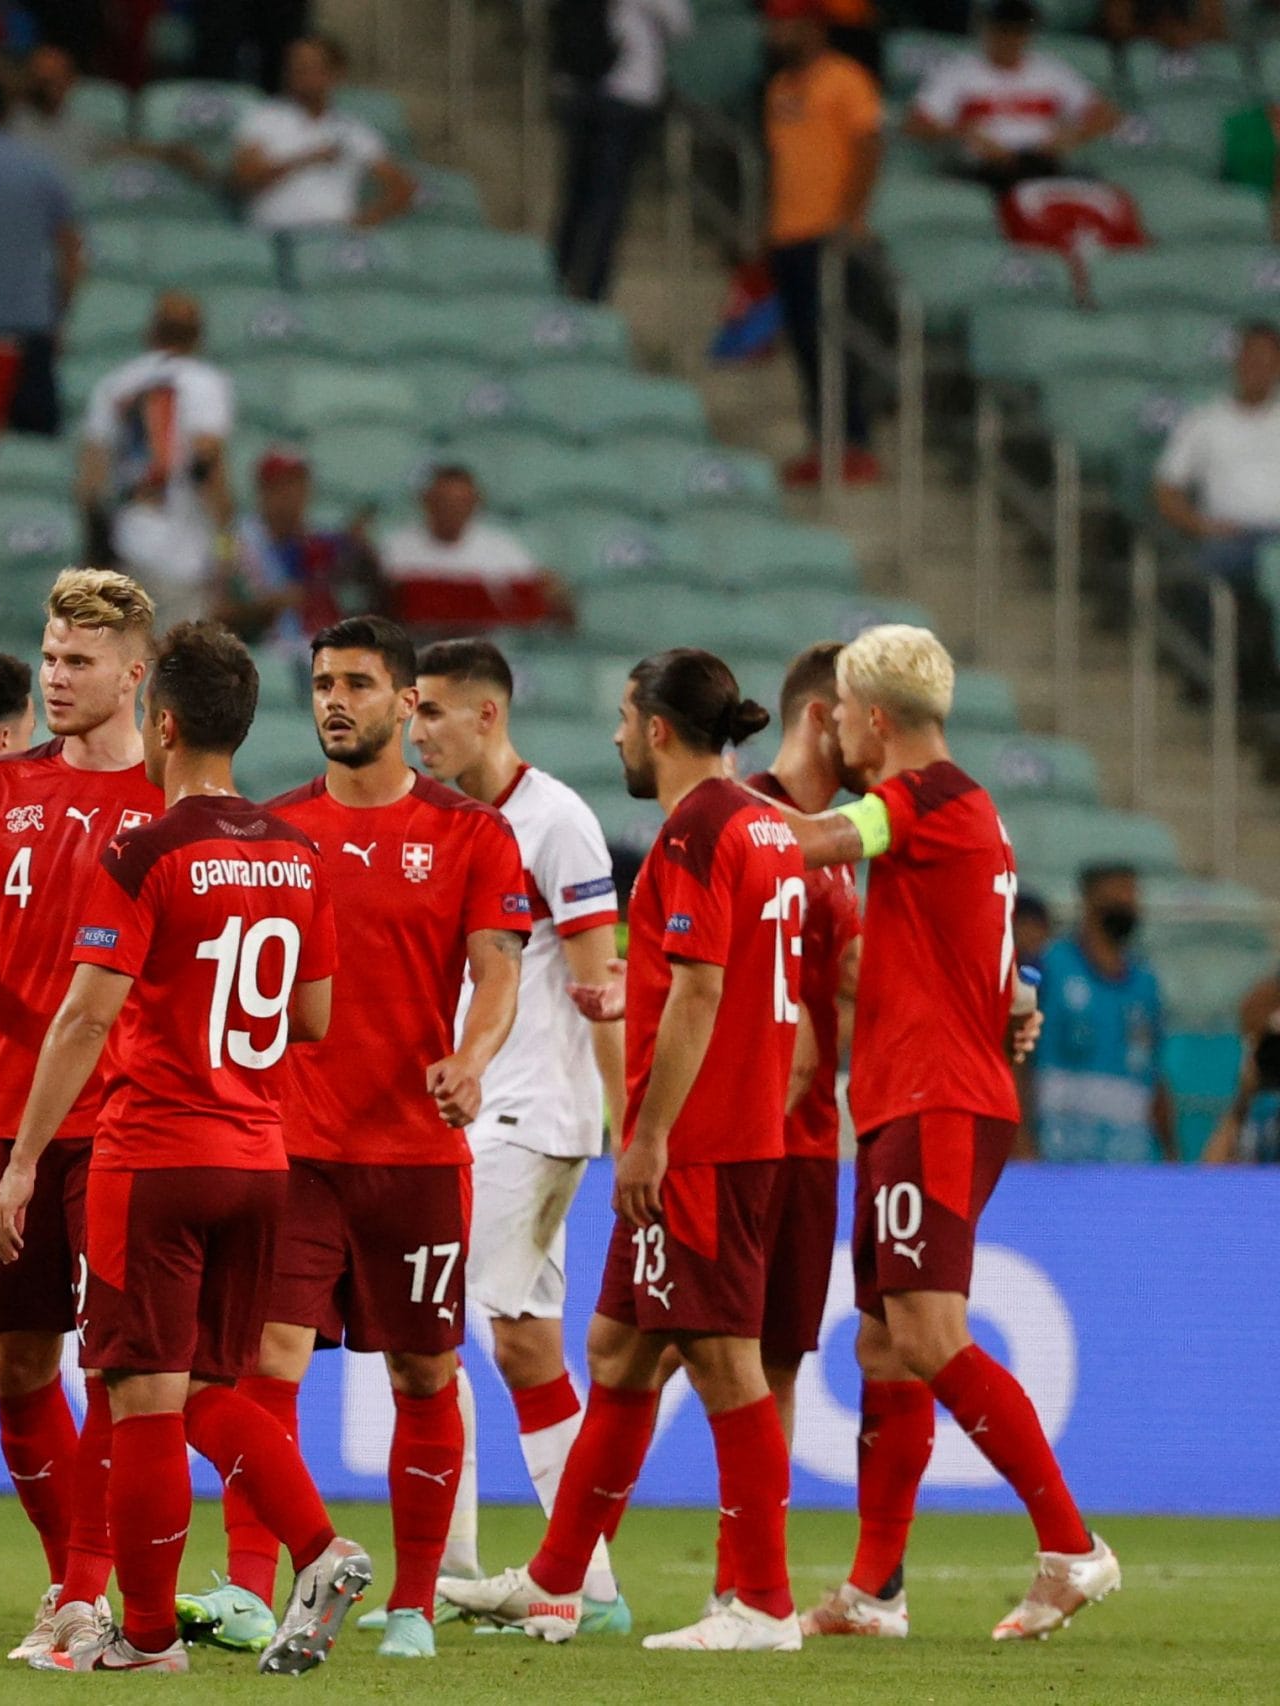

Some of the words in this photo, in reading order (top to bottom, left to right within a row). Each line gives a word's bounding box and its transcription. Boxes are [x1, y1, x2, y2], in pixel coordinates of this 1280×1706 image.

[4, 846, 33, 909] 4
[191, 855, 312, 895] gavranovic
[195, 916, 300, 1070] 19
[874, 1180, 922, 1242] 10
[403, 1241, 461, 1304] 17
[632, 1223, 667, 1285] 13
